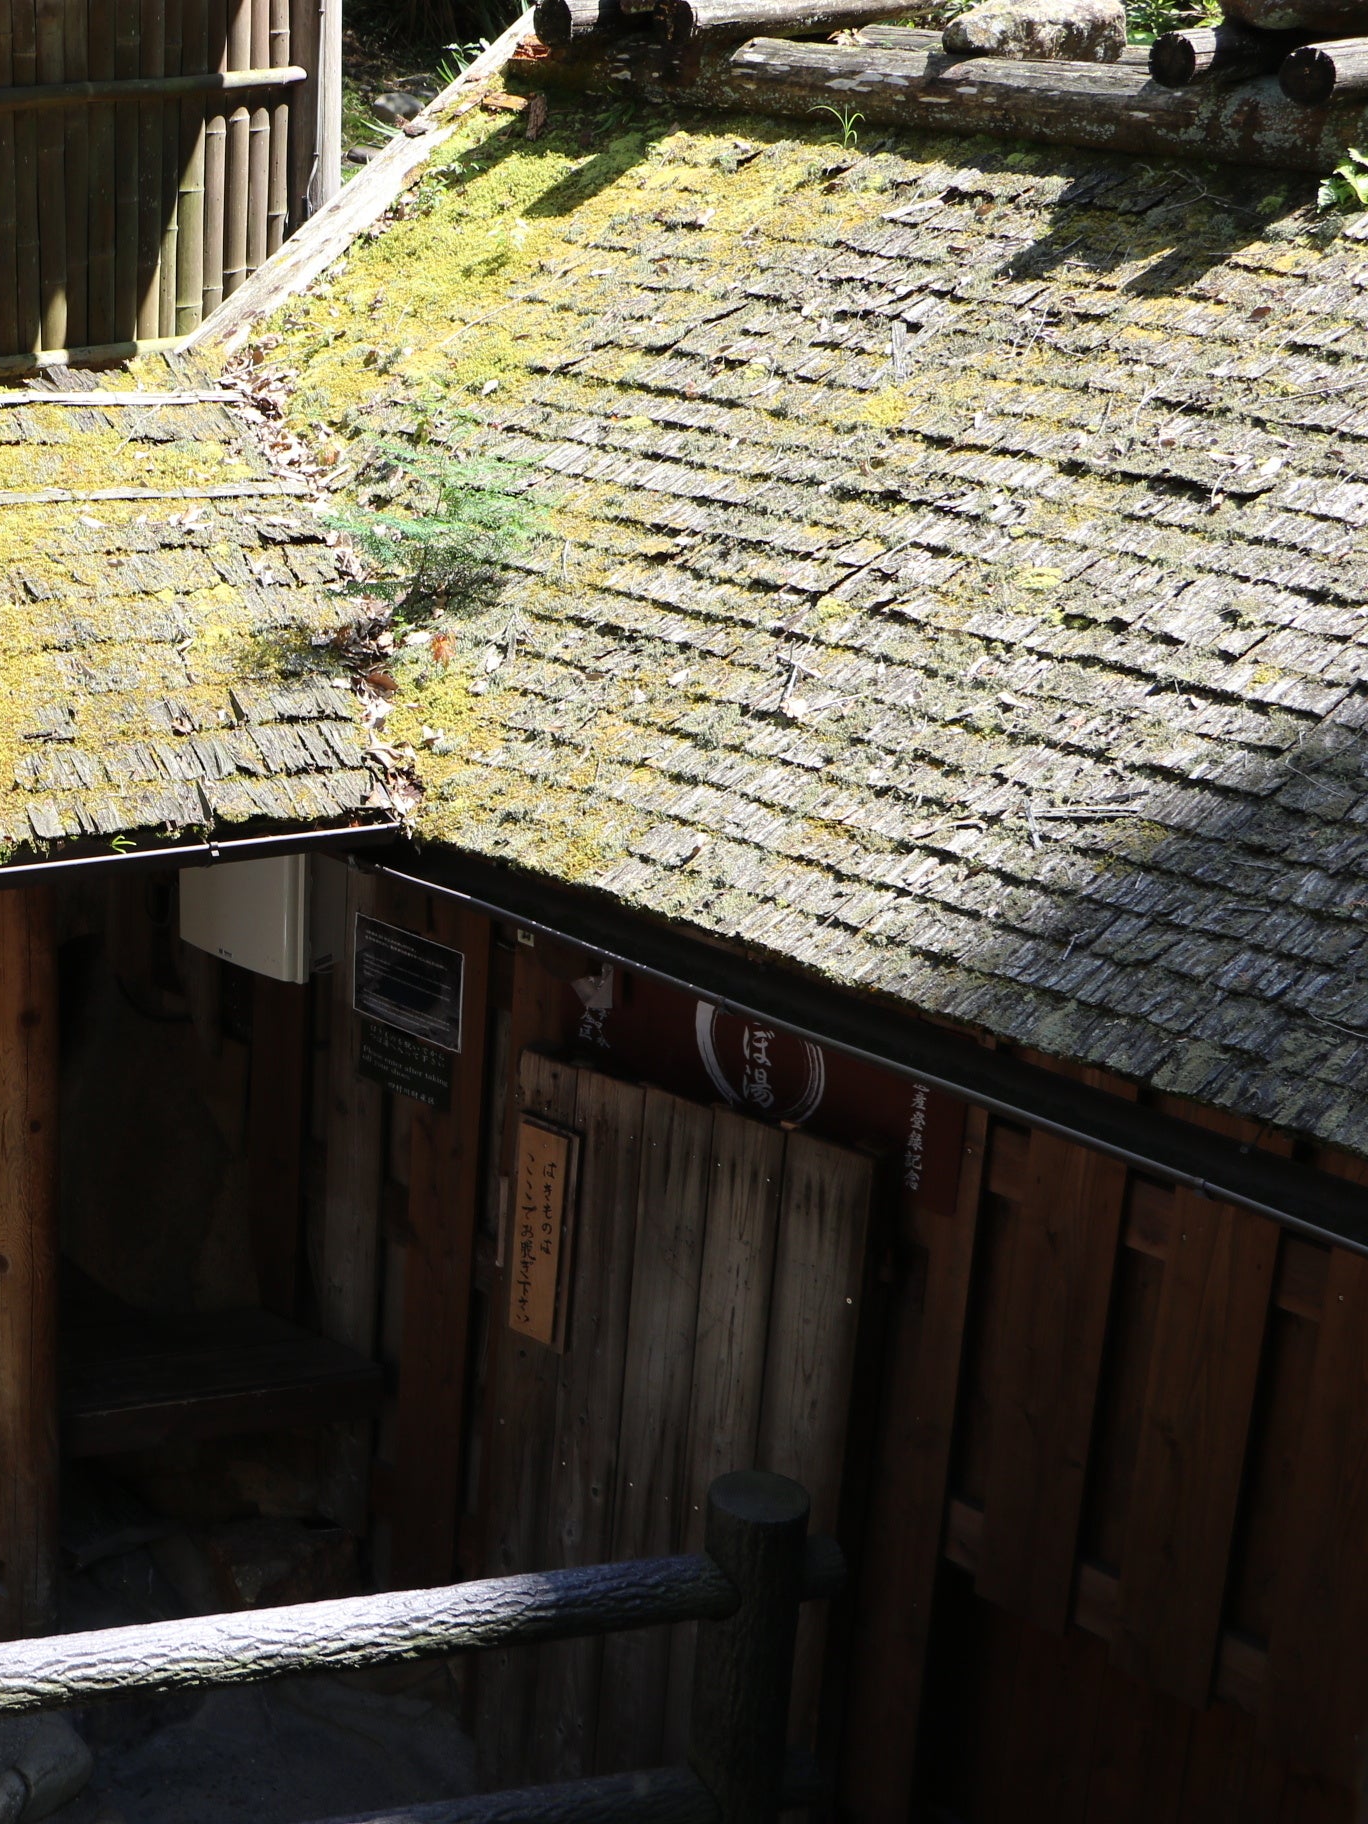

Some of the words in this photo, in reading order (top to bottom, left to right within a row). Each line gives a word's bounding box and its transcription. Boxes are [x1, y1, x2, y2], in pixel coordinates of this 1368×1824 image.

[384, 1058, 402, 1069] enter
[404, 1066, 422, 1077] after
[425, 1073, 448, 1088] taking
[743, 1022, 775, 1108] ぼ湯
[540, 1162, 558, 1256] はきものは
